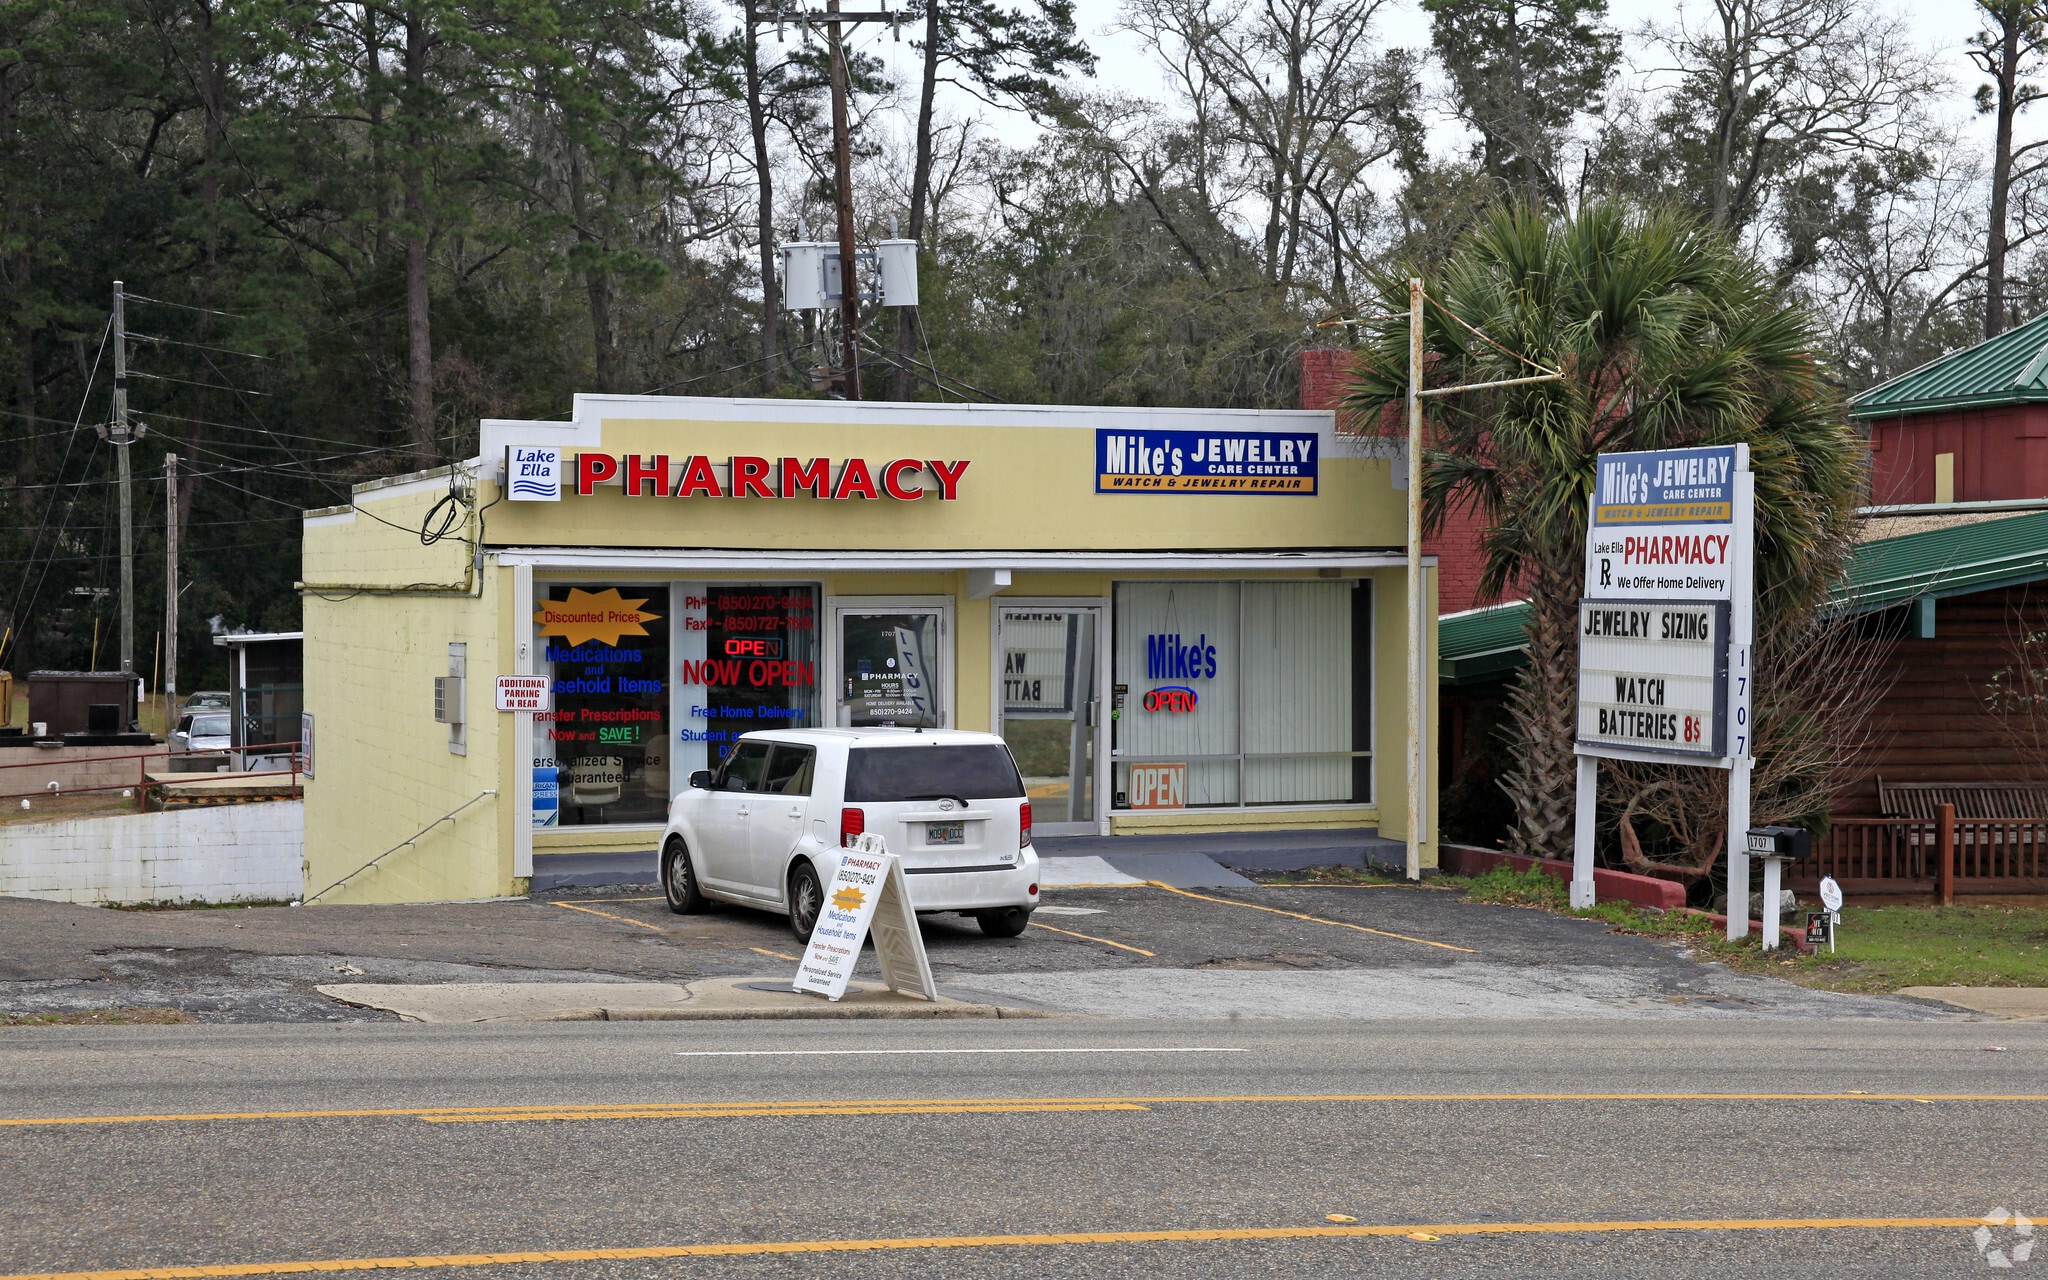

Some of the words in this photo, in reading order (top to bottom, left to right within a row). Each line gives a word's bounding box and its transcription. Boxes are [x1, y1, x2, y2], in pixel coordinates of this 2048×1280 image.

[515, 449, 556, 463] Lake
[1106, 435, 1183, 476] Mike's
[1191, 438, 1312, 463] JEWELRY
[520, 463, 551, 477] Ella
[576, 453, 971, 501] PHARMACY
[1208, 464, 1243, 474] CARE
[1247, 464, 1299, 475] CENTER
[1113, 477, 1162, 487] WATCH
[1167, 478, 1177, 487] &
[1183, 478, 1246, 488] JEWELRY
[1250, 479, 1302, 488] REPAIR
[1602, 461, 1649, 505] Mike's
[1653, 456, 1730, 488] JEWELRY
[1663, 489, 1685, 500] CARE
[1687, 487, 1722, 499] CENTER
[1604, 508, 1633, 519] WATCH
[1636, 508, 1643, 518] &
[1645, 507, 1686, 518] JEWELRY
[1688, 506, 1723, 516] REPAIR
[1594, 542, 1610, 554] Lake
[1611, 542, 1624, 553] Ella
[1624, 534, 1730, 565] PHARMACY
[1617, 576, 1631, 589] We
[1633, 576, 1655, 589] Offer
[1657, 576, 1684, 589] Home
[1686, 576, 1725, 592] Delivery
[545, 611, 604, 623] Discounted
[608, 611, 641, 623] Prices
[1585, 610, 1650, 638] JEWELRY
[1661, 612, 1708, 640] SIZING
[545, 645, 643, 663] Medications
[725, 639, 779, 656] OPEN
[1148, 633, 1217, 679] Mike's
[584, 664, 604, 675] and
[683, 659, 743, 686] NOW
[749, 659, 815, 687] OPEN
[869, 672, 919, 680] PHARMACY
[499, 679, 546, 688] ADDITIONAL
[550, 676, 611, 693] usehold
[619, 676, 662, 693] Items
[1615, 676, 1665, 706] WATCH
[504, 689, 540, 698] PARKING
[1144, 689, 1196, 713] OPEN
[506, 699, 515, 708] IN
[517, 699, 538, 708] REAR
[532, 708, 576, 722] ransfer
[581, 708, 661, 724] Prescriptions
[691, 705, 717, 718] Free
[720, 705, 754, 718] Home
[758, 705, 805, 721] Delivery
[1599, 708, 1677, 741] BATTERIES
[548, 728, 577, 741] Now
[578, 731, 596, 741] and
[599, 727, 632, 741] SAVE
[681, 728, 727, 742] Student
[533, 754, 607, 768] ersonalized
[1131, 767, 1184, 806] OPEN
[1750, 836, 1767, 848] 1707
[846, 857, 881, 871] PHARMACY
